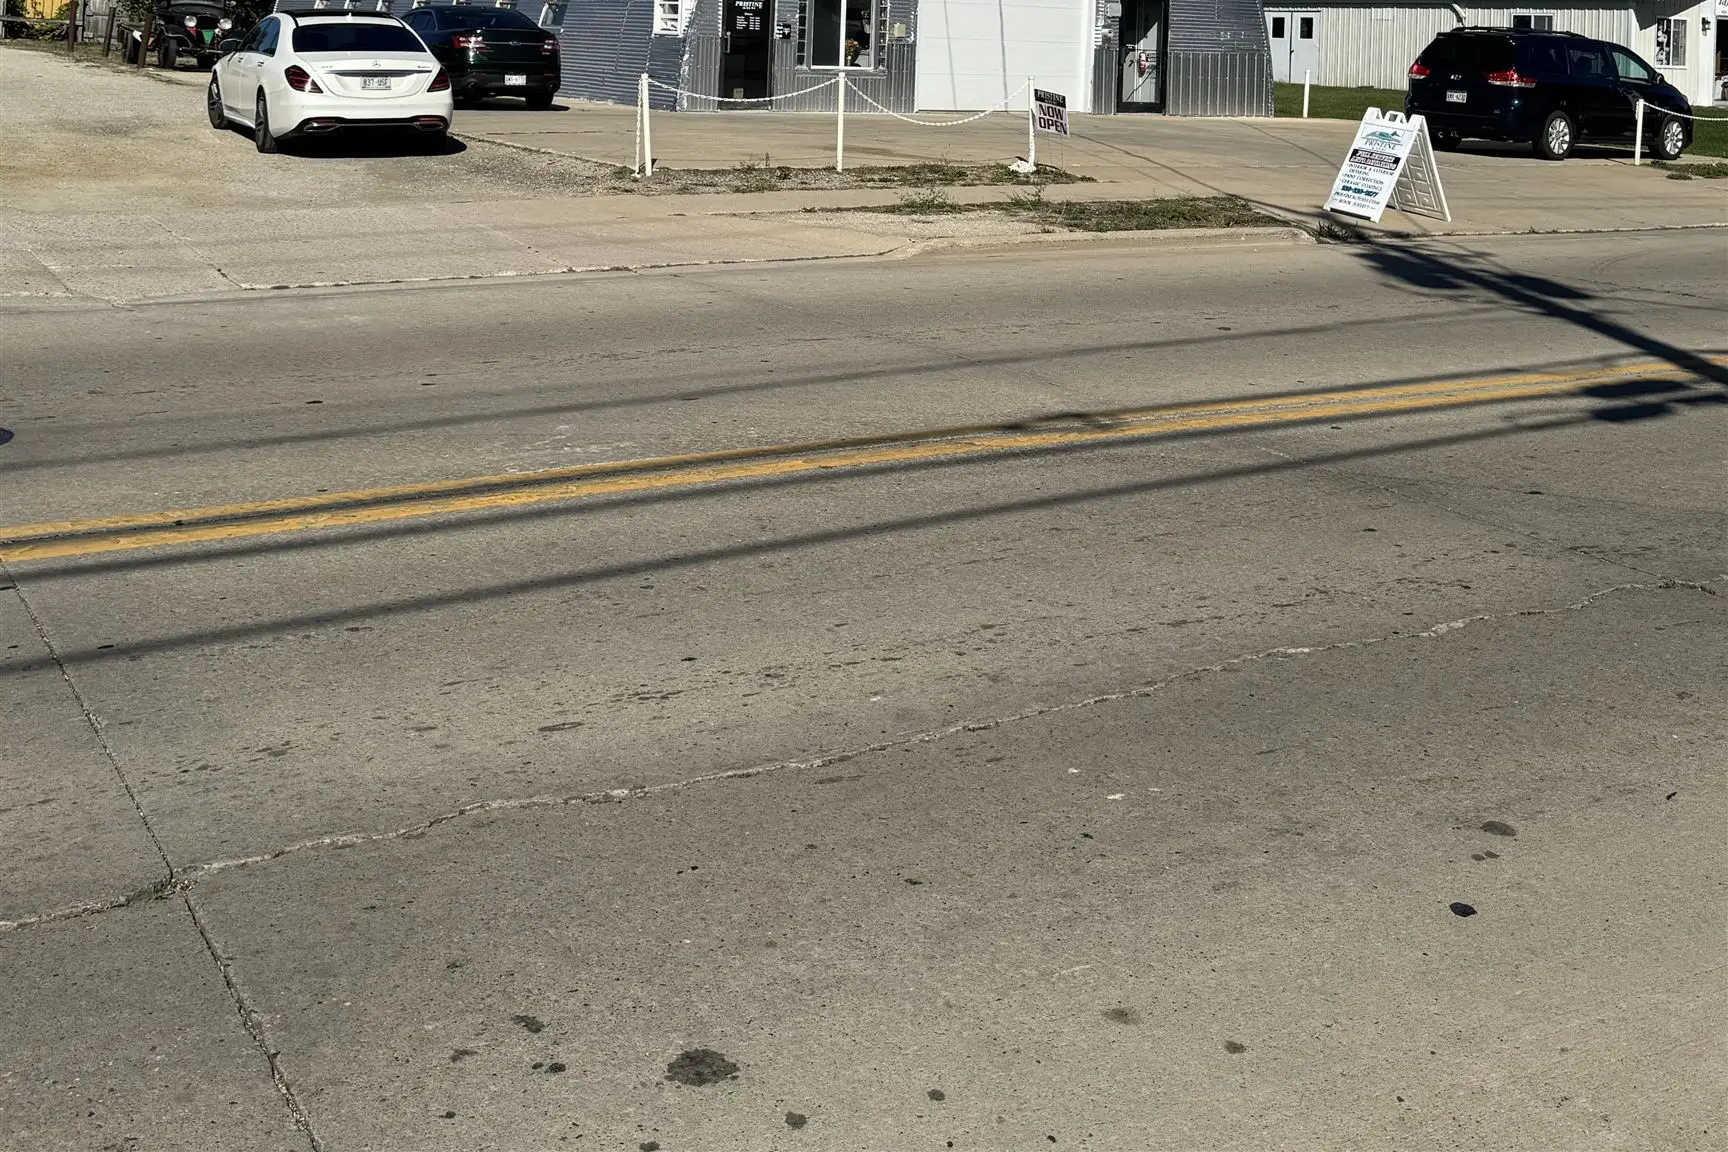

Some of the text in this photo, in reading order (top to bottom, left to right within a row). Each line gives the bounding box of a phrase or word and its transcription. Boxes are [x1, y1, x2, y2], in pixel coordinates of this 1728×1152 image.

[735, 0, 763, 9] PRISTINE
[1037, 90, 1064, 103] PRISTINE
[1038, 103, 1064, 121] NOW
[1038, 116, 1068, 135] OPEN
[1364, 139, 1397, 150] PRISTINE
